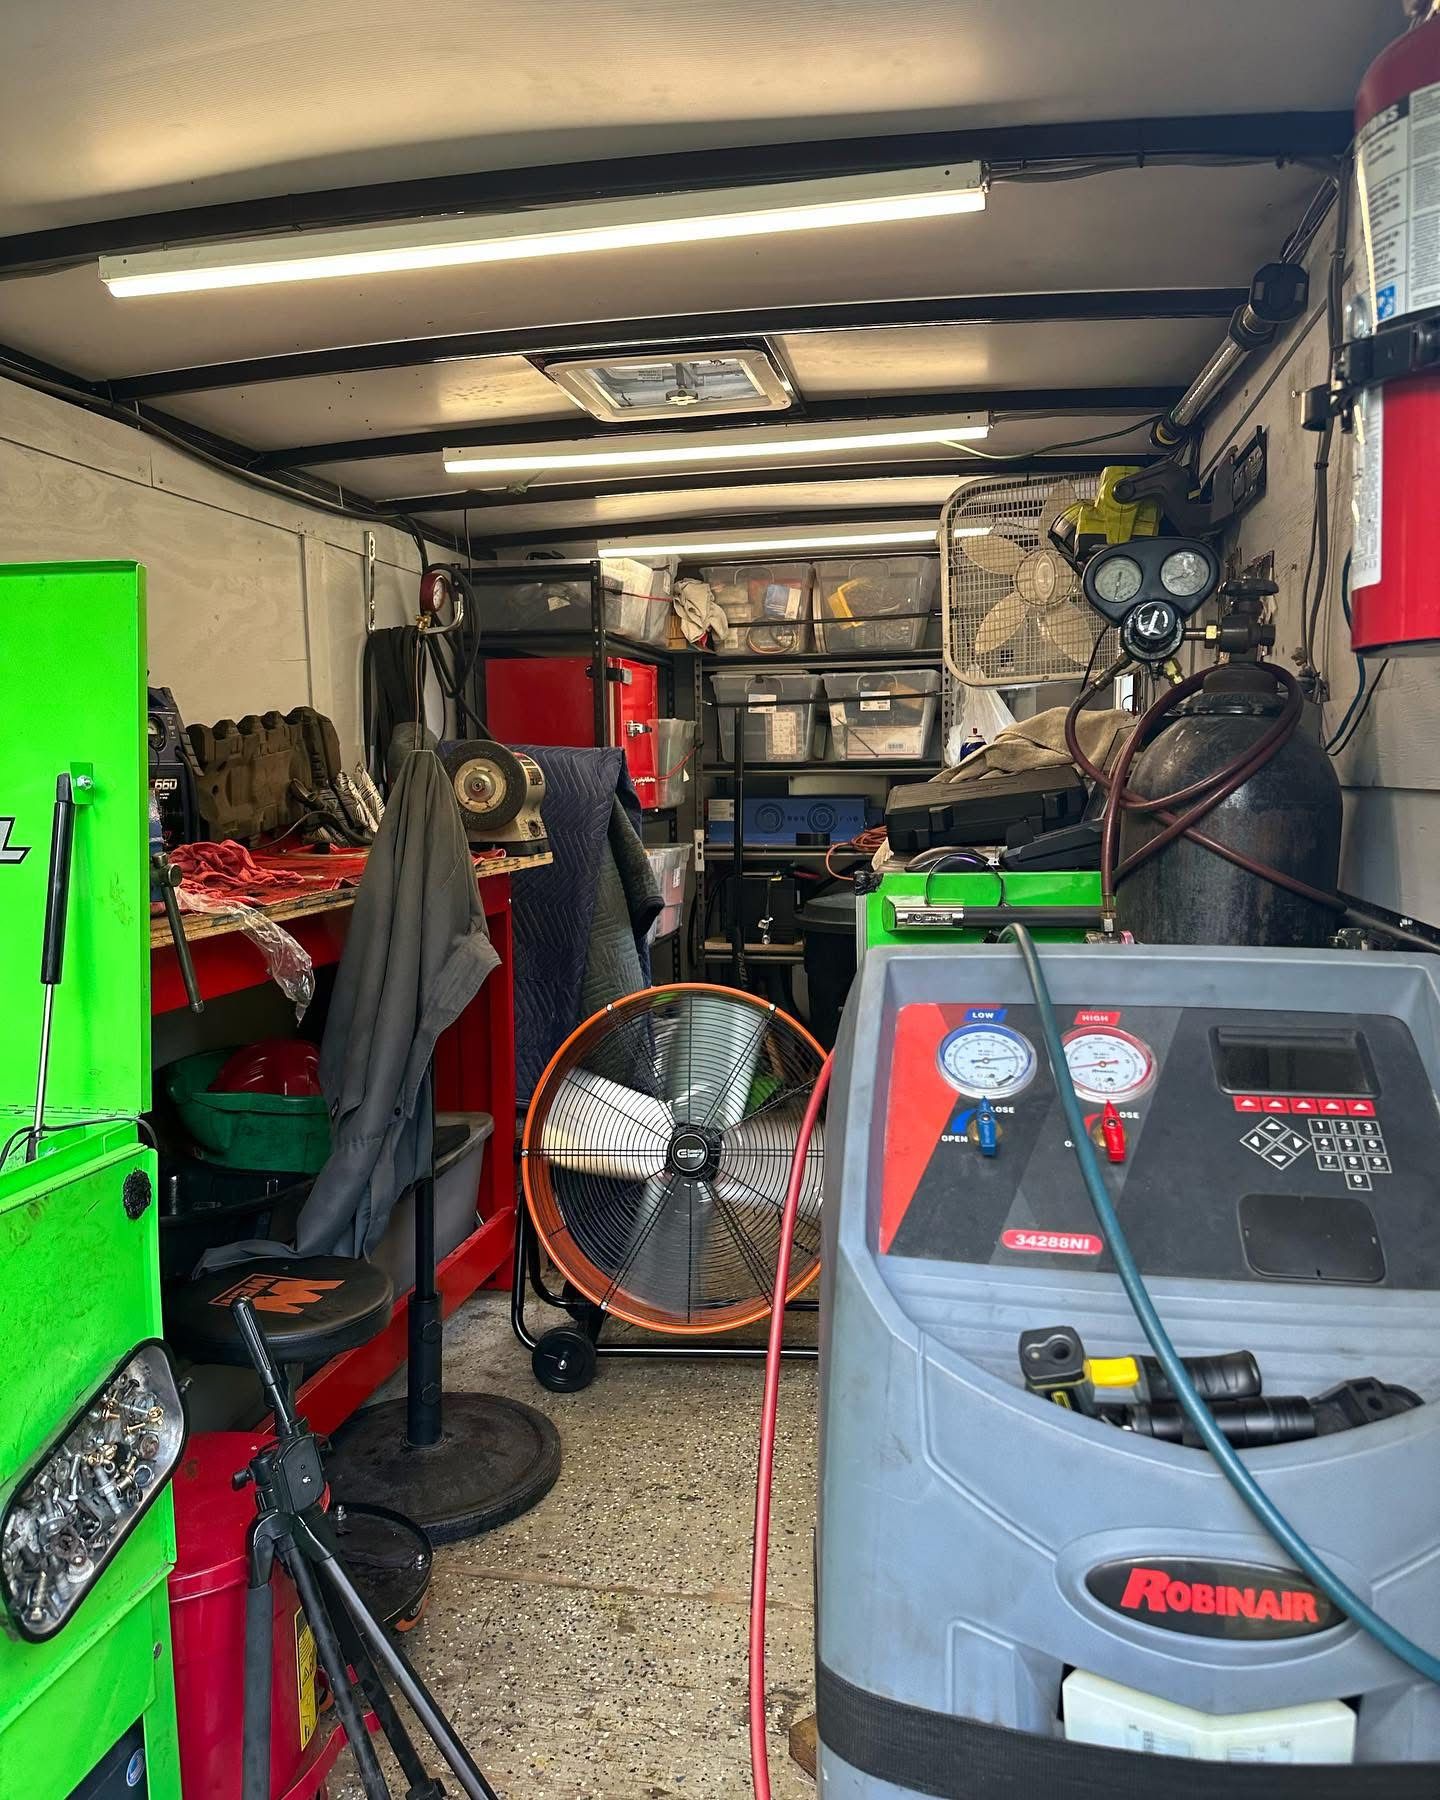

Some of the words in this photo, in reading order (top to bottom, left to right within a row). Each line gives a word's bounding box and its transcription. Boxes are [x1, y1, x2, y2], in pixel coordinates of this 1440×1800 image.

[971, 1011, 995, 1020] LOW
[1081, 1014, 1109, 1023] HIGH
[990, 1105, 1016, 1114] LOSE
[1316, 1121, 1324, 1130] 1
[1339, 1122, 1349, 1130] 2
[1363, 1123, 1373, 1131] 3
[940, 1134, 969, 1144] OPEN
[1320, 1138, 1329, 1146] 4
[1344, 1138, 1353, 1147] 5
[1368, 1140, 1378, 1148] 6
[1324, 1155, 1332, 1164] 7
[1348, 1156, 1358, 1165] 8
[1372, 1157, 1382, 1166] 9
[1353, 1174, 1363, 1184] 0
[1015, 1233, 1090, 1250] 34288NI
[1120, 1567, 1319, 1623] ROBINAIR
